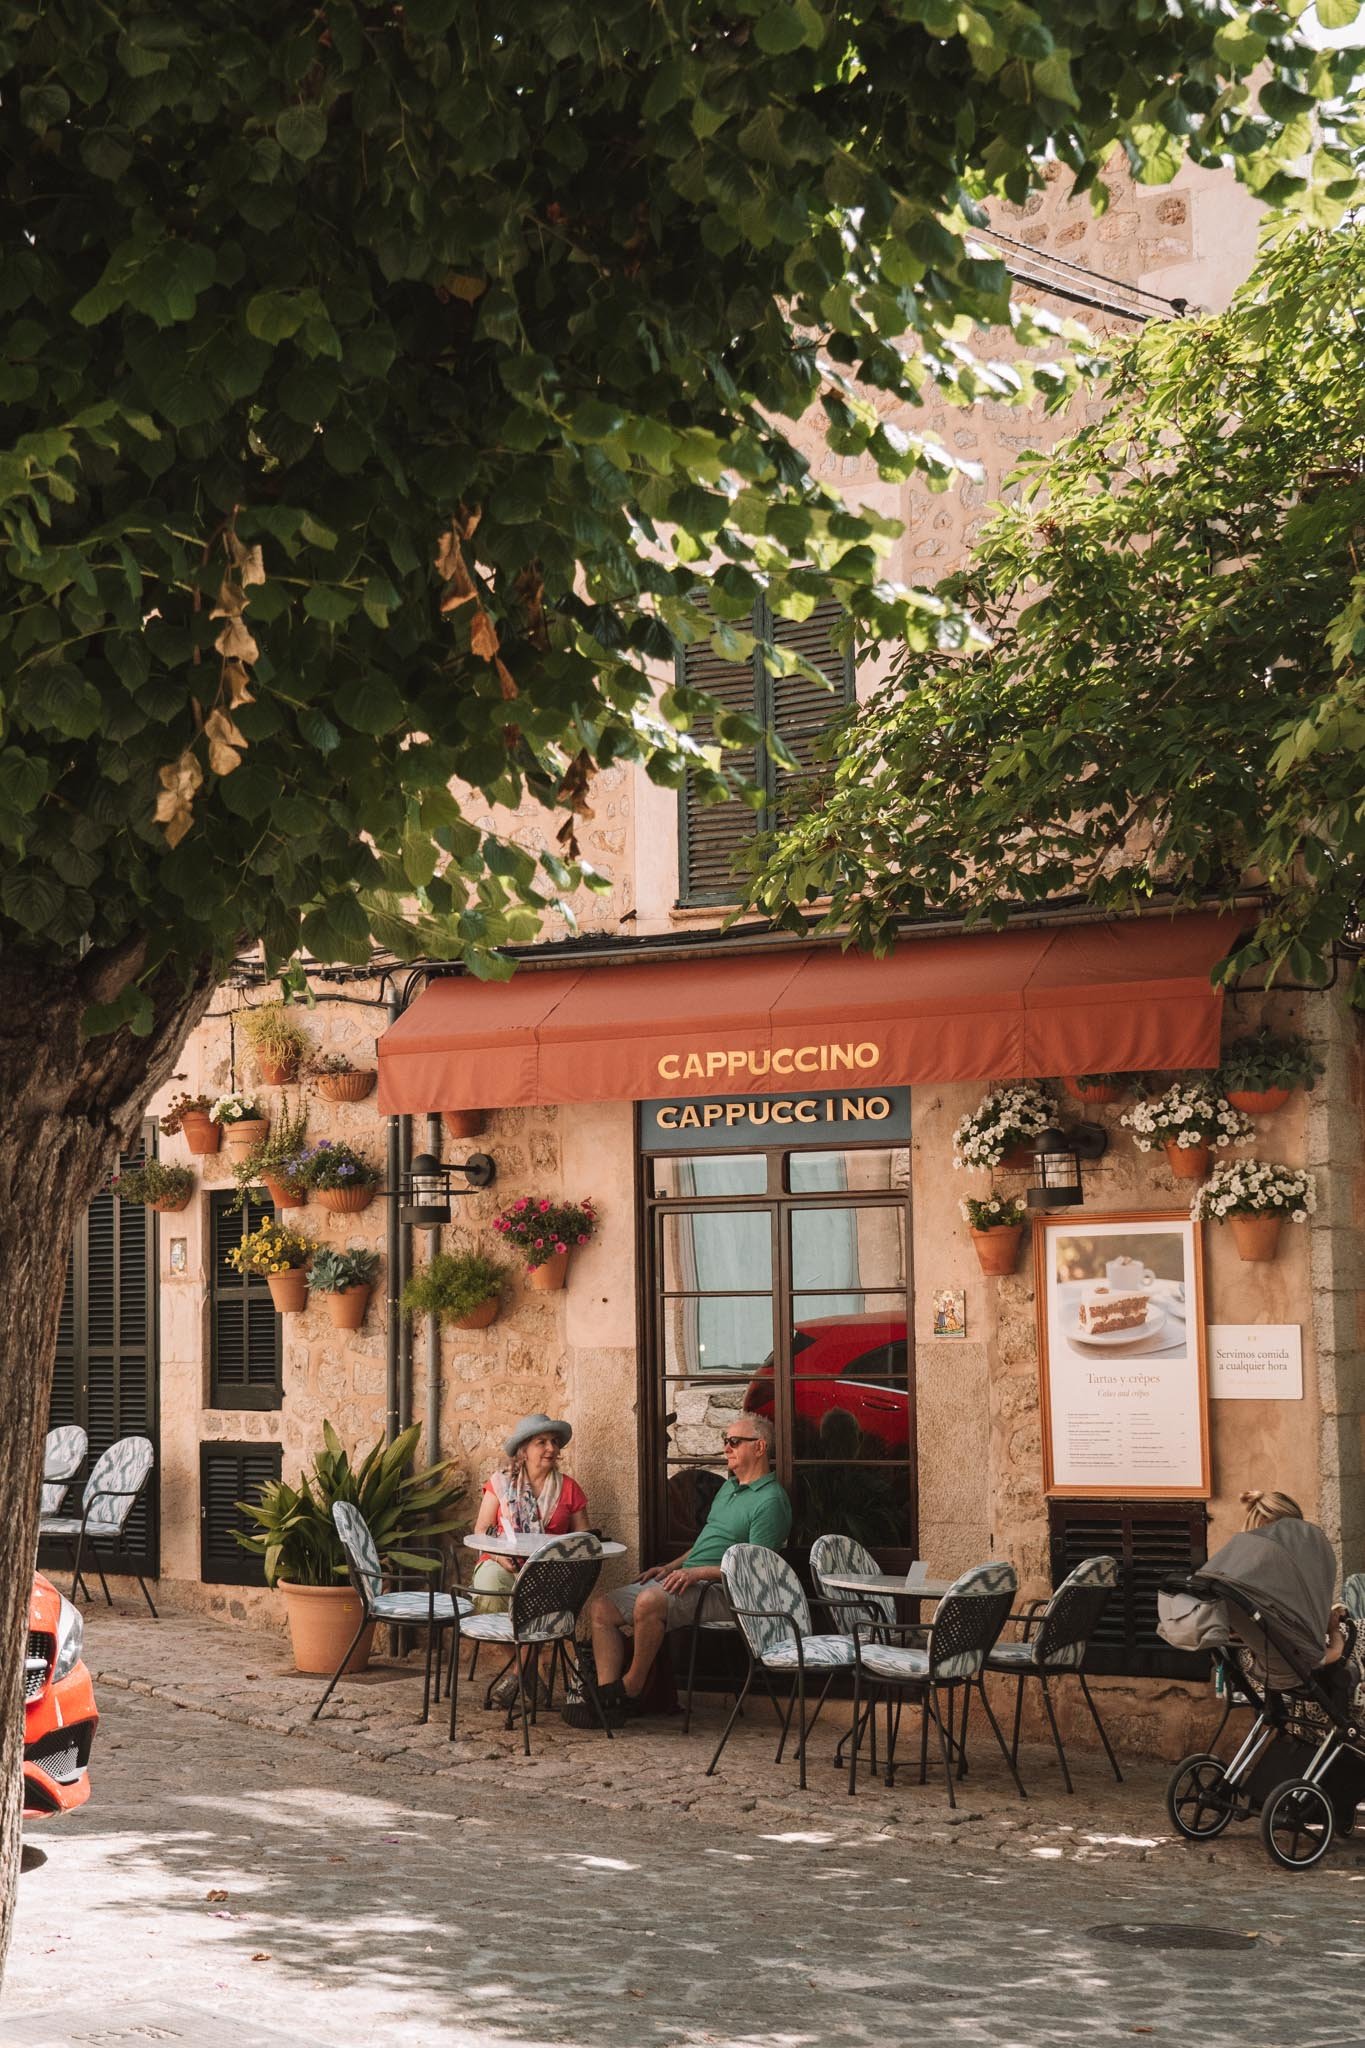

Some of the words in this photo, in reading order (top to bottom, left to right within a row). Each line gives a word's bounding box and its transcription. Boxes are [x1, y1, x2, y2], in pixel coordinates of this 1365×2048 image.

[657, 1042, 880, 1080] CAPPUCCINO
[656, 1096, 890, 1129] CAPPUCCINO
[1216, 1348, 1256, 1359] Servimos
[1257, 1348, 1289, 1359] comida
[1226, 1360, 1265, 1373] cualquier
[1267, 1360, 1288, 1370] hora
[1086, 1373, 1117, 1384] Tartas
[1119, 1375, 1126, 1386] y
[1128, 1372, 1161, 1386] crêpes
